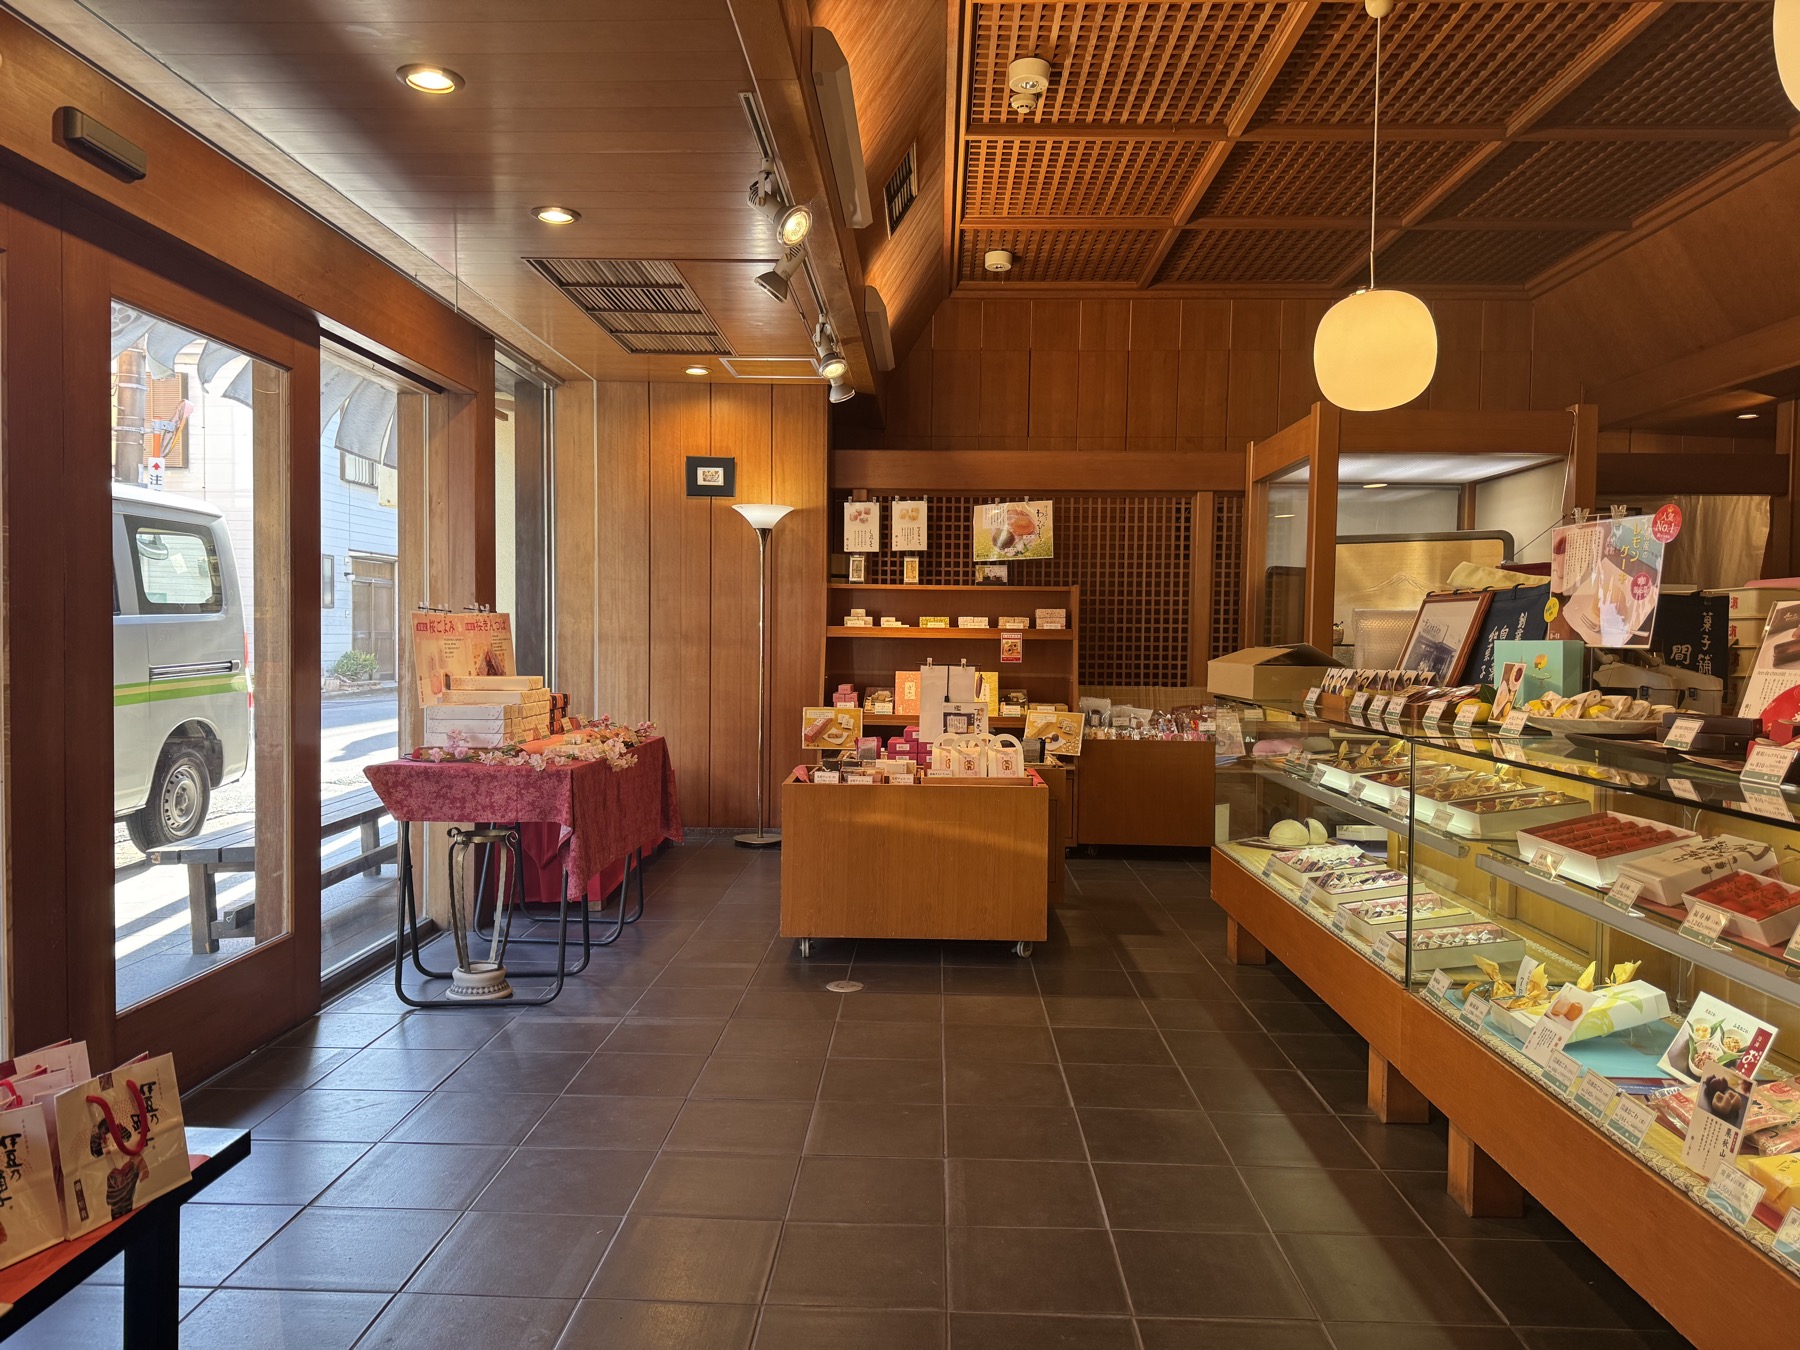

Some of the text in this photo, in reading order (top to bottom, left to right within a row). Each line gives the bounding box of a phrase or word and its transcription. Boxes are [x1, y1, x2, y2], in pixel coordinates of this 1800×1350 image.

[1655, 520, 1675, 534] No.1
[1660, 512, 1674, 521] 人気
[1630, 522, 1642, 562] レモン
[1618, 545, 1631, 585] ケーキ
[429, 618, 456, 635] 桜ごよみ
[475, 618, 508, 633] 桜きんつば
[1670, 644, 1693, 668] 間
[1734, 1049, 1759, 1075] おこ
[1719, 1127, 1732, 1158] 栗秋山
